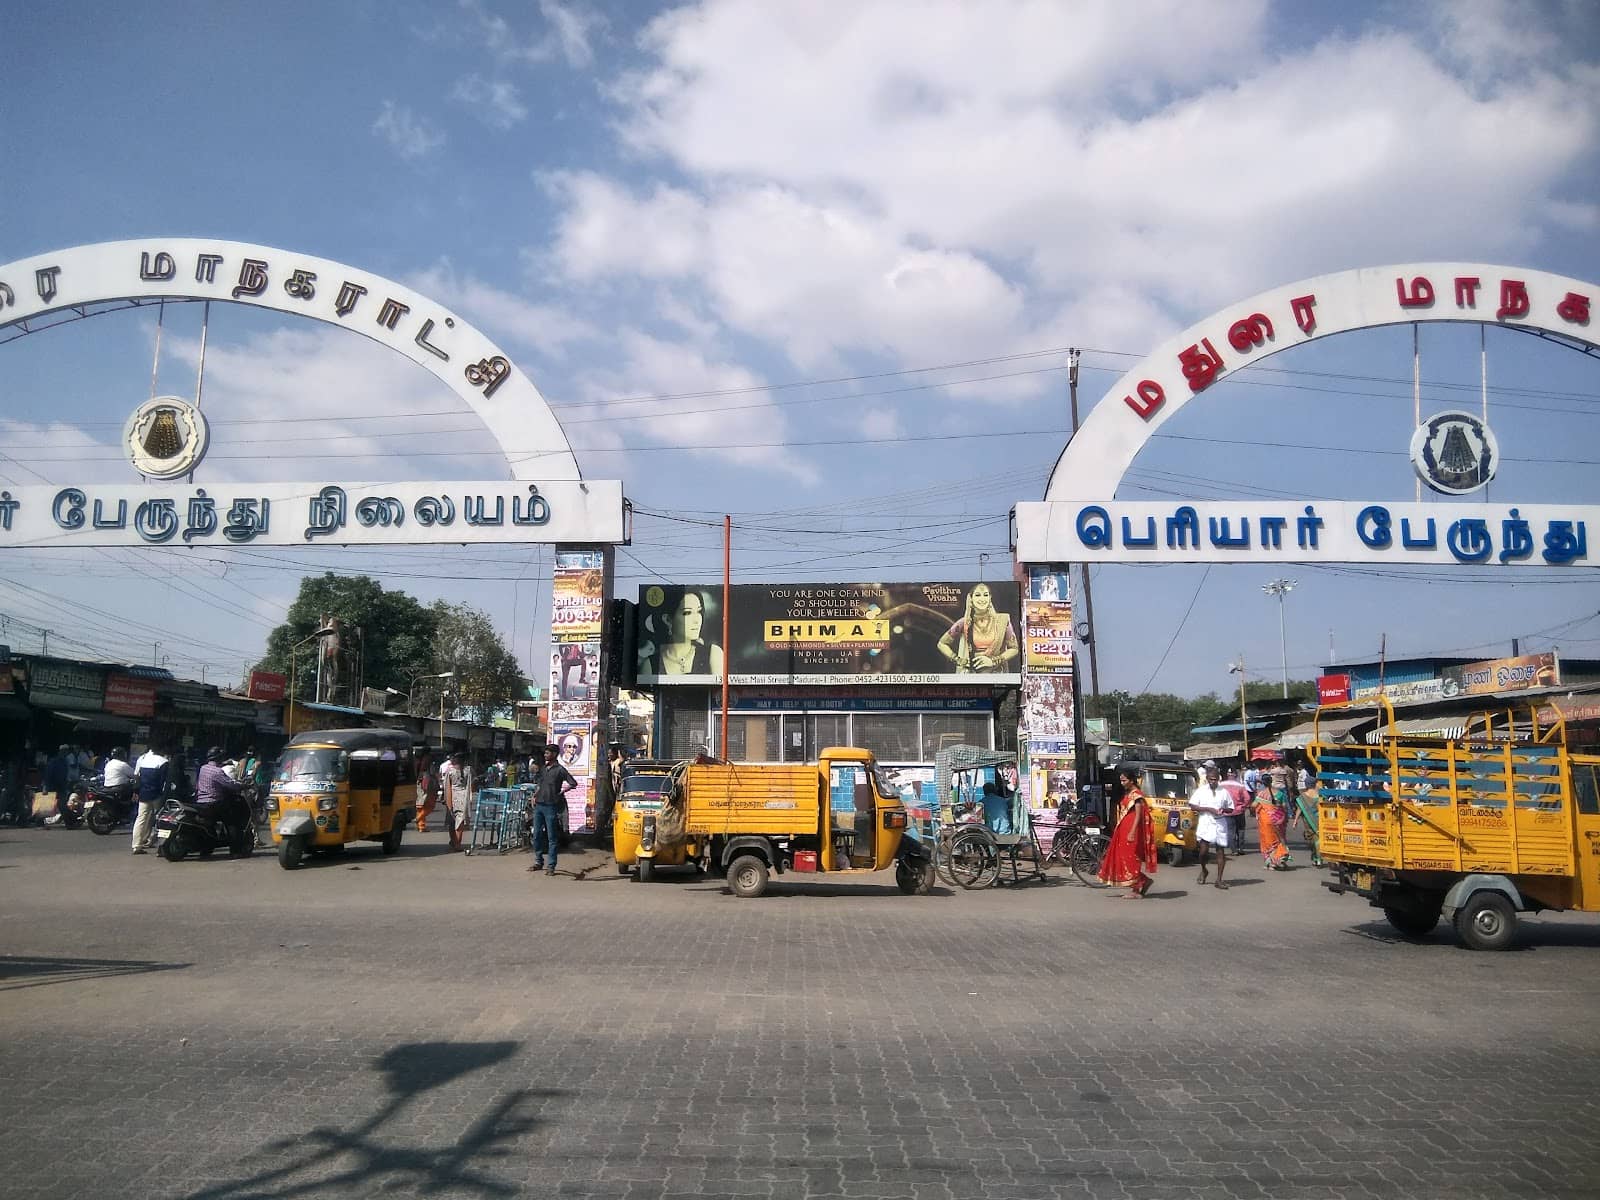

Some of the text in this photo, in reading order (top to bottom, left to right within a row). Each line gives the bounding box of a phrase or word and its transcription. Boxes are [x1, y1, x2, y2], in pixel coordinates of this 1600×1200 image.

[140, 251, 512, 398] மாநகராட்சி
[1124, 294, 1318, 422] மதுரை
[52, 488, 270, 541] பேருந்து
[305, 485, 551, 539] நிலையம்
[1076, 505, 1587, 564] பெரியார் பேருந்து
[770, 589, 886, 598] YOU ARE ONE OF A KIND
[922, 586, 961, 594] Pavithra
[793, 599, 861, 607] SO SHOULD BE
[787, 609, 816, 618] YOUR
[1029, 628, 1055, 638] SRK
